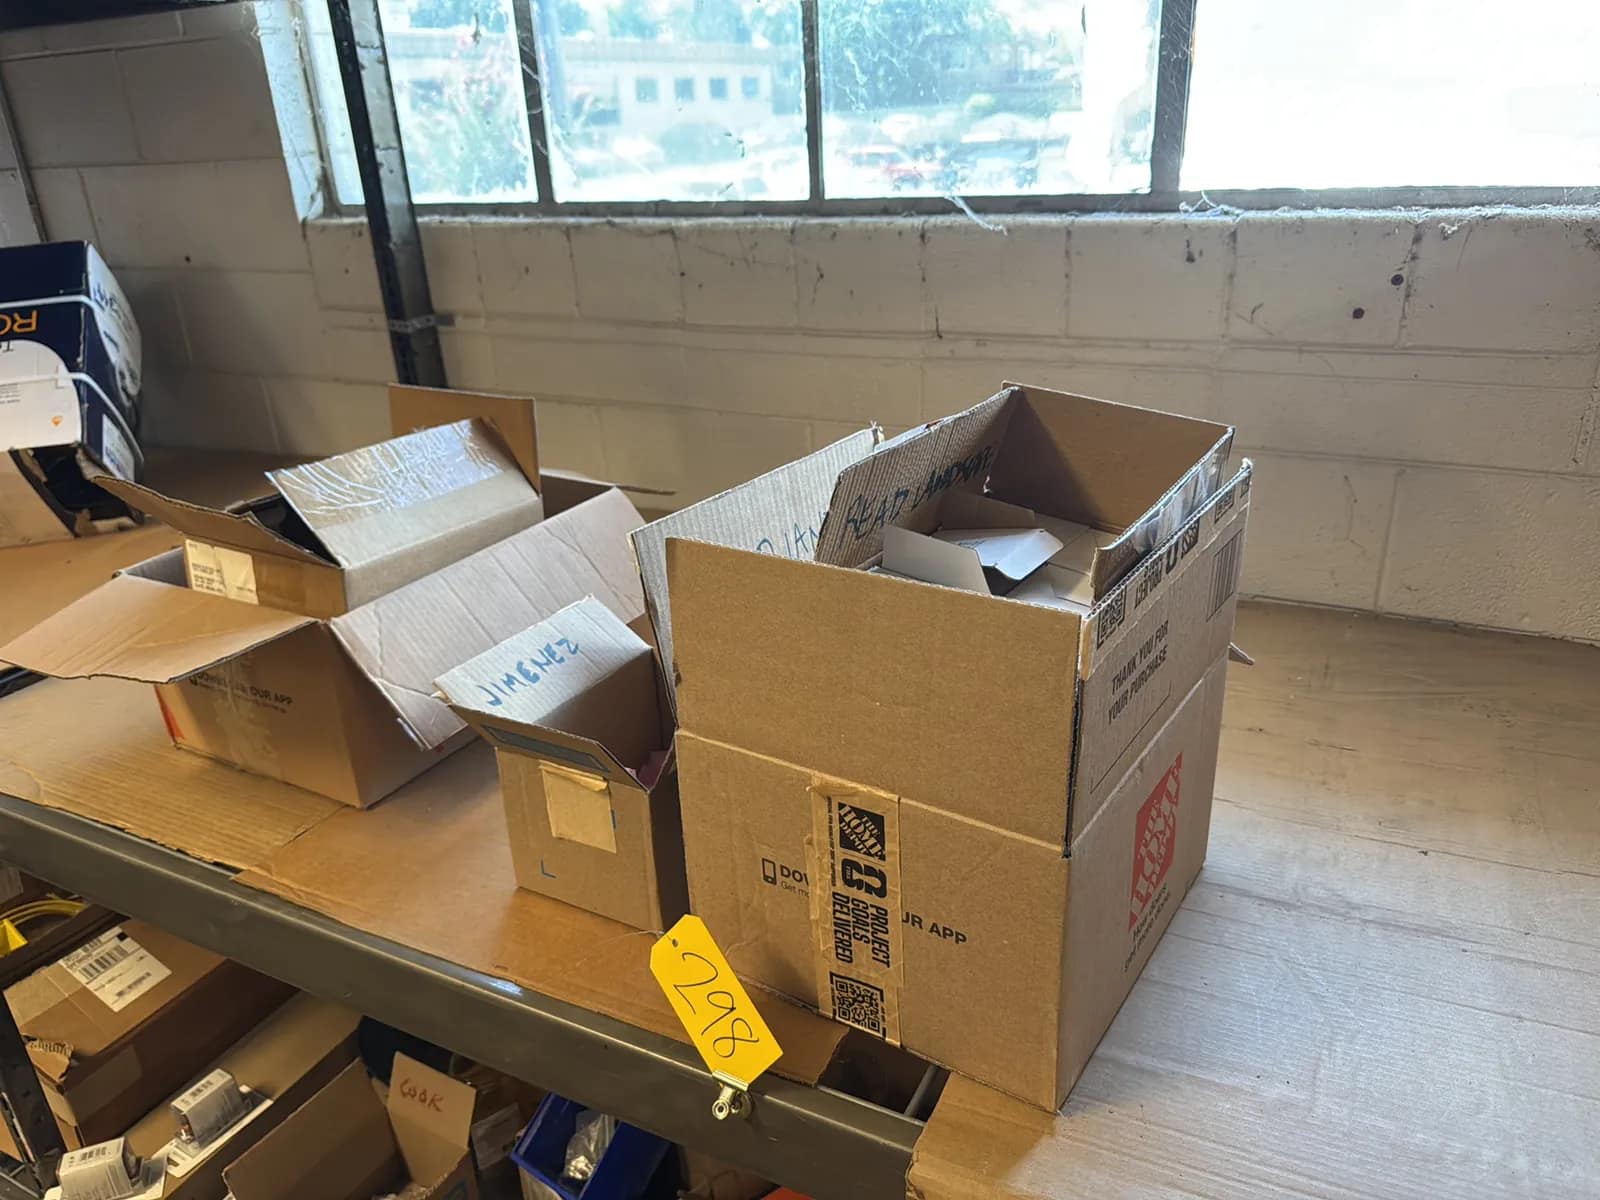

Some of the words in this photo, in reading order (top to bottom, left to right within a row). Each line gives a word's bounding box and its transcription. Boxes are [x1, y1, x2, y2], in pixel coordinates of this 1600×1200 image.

[476, 637, 579, 706] JIMENEZ
[1108, 689, 1129, 725] YOUR
[1129, 644, 1168, 700] PURCHASE
[1112, 652, 1138, 695] THANK
[1139, 634, 1154, 664] YOU
[1154, 619, 1169, 649] FOR
[780, 864, 809, 886] DO
[929, 922, 967, 944] APP
[832, 891, 853, 963] DELIVERED
[851, 898, 870, 944] GOALS
[870, 904, 890, 968] PROJECT
[673, 951, 760, 1058] 298
